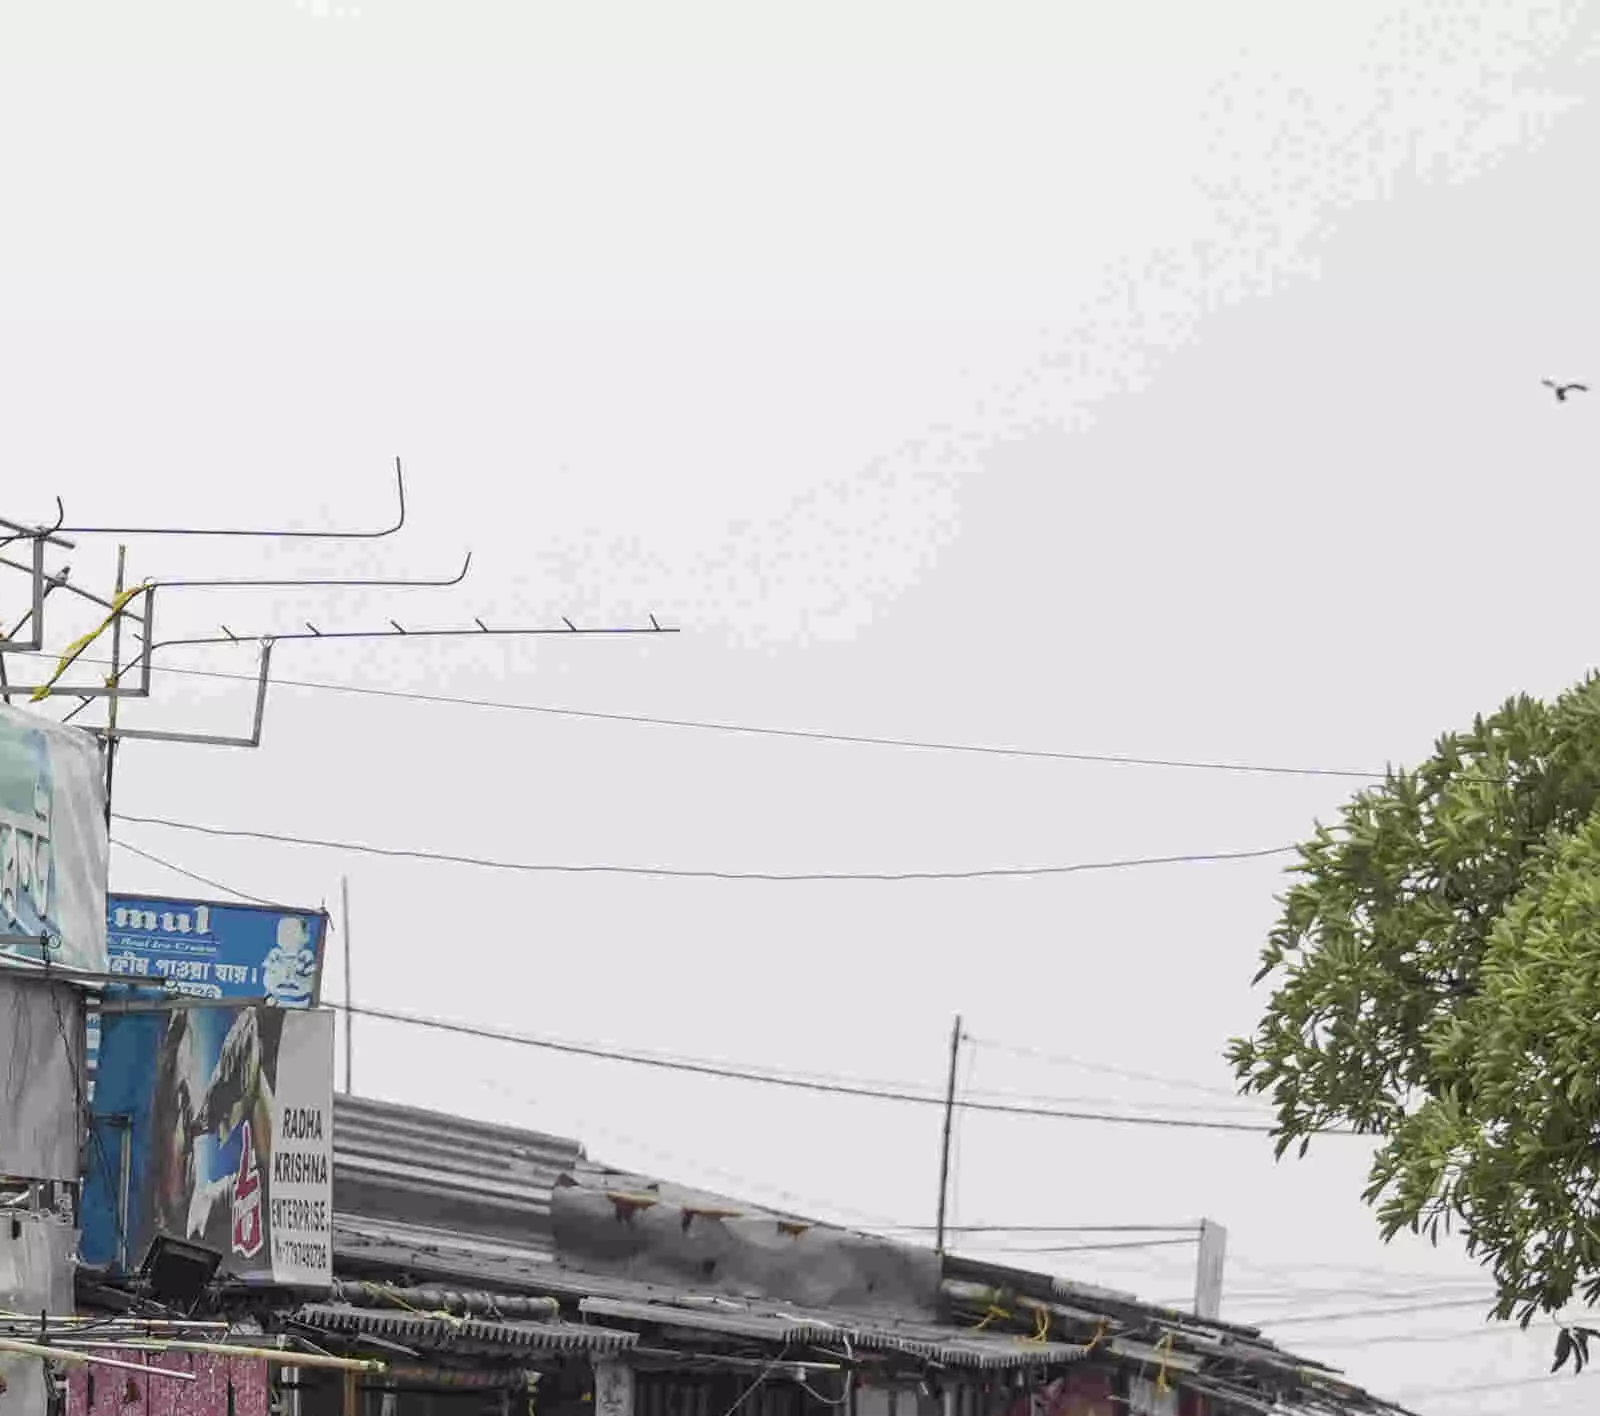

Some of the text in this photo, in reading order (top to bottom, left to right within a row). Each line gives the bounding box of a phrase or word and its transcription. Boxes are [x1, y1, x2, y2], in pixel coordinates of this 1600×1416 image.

[108, 904, 212, 936] mul
[282, 1107, 323, 1140] RADHA
[273, 1151, 328, 1185] KRISHNA
